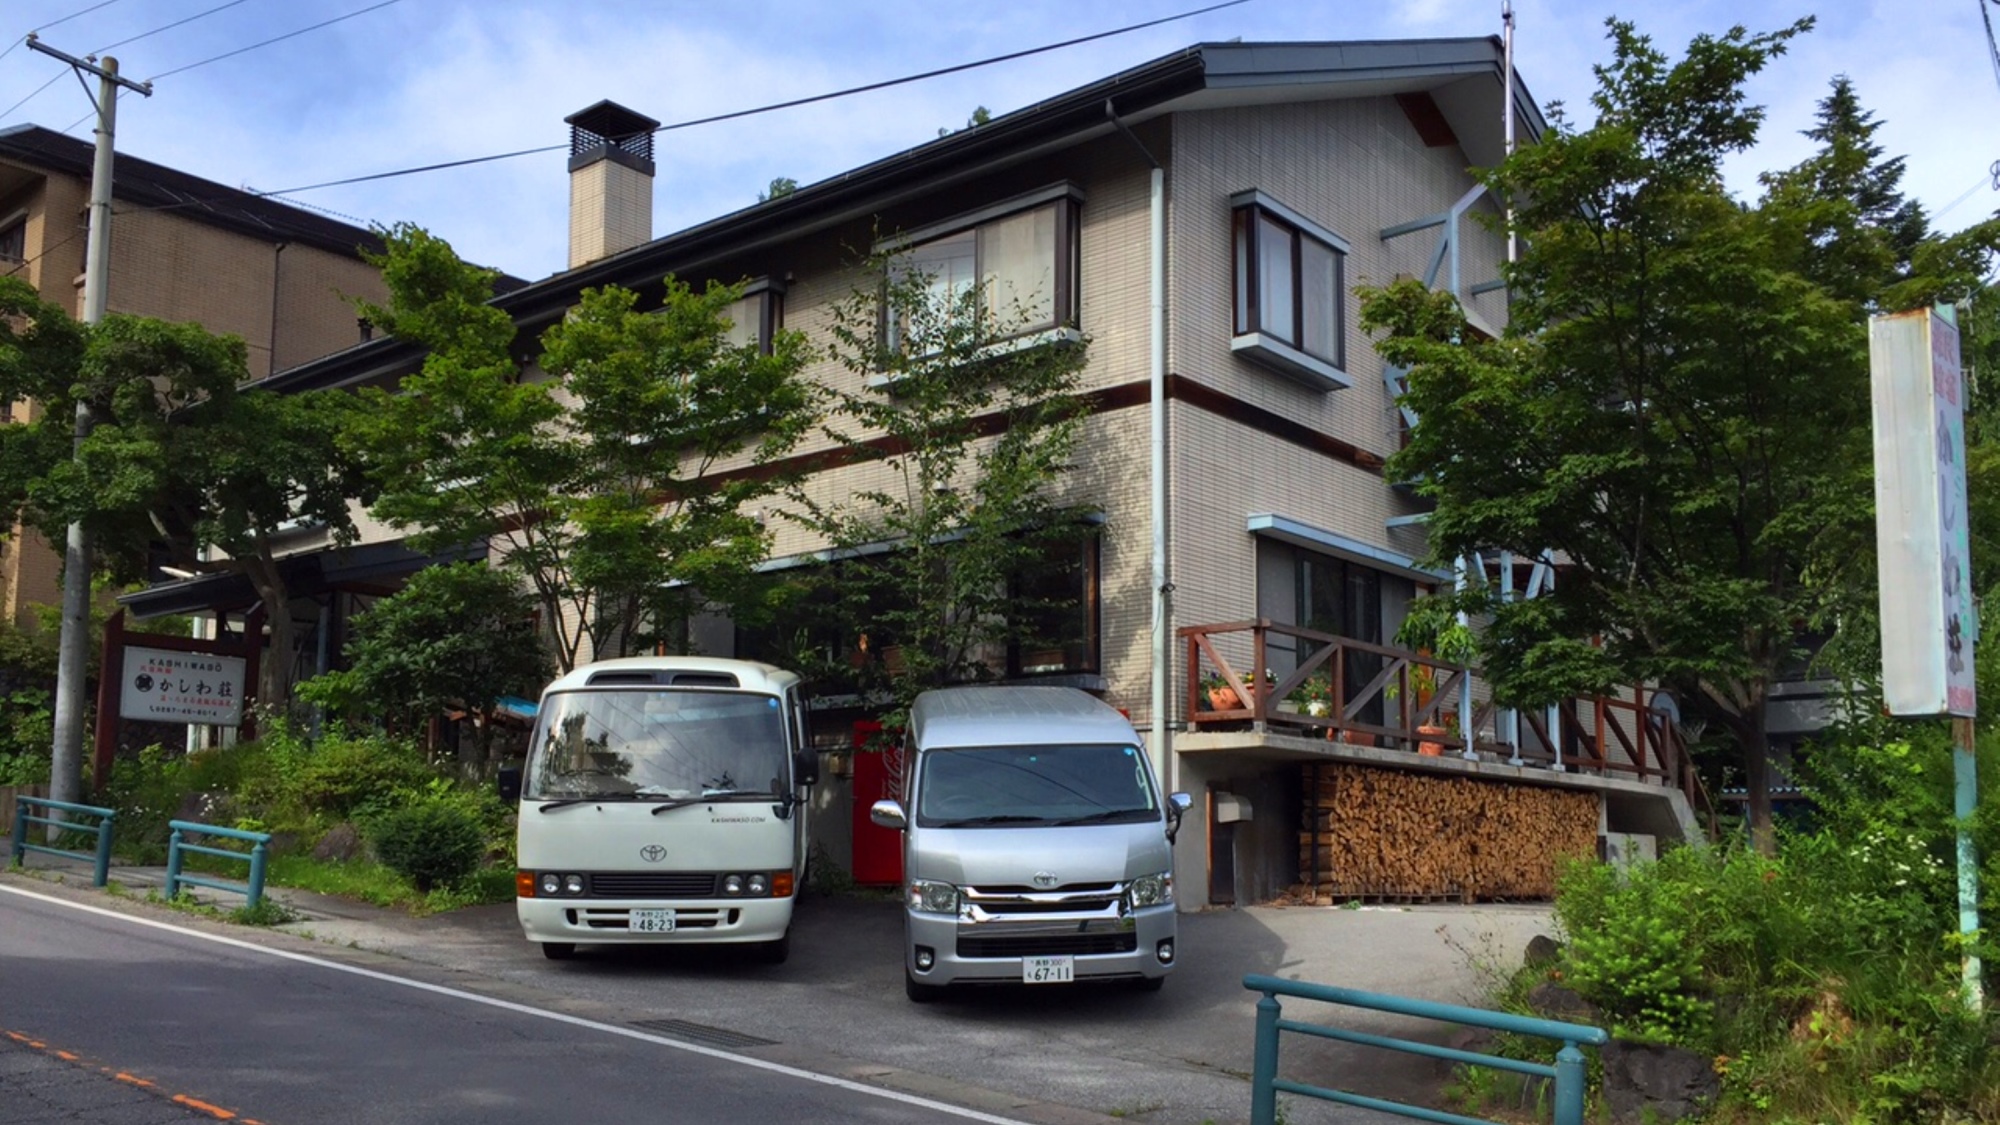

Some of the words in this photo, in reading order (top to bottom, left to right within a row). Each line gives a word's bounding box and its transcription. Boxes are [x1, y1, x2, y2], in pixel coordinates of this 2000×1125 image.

[160, 679, 233, 697] かしわ荘
[639, 919, 673, 931] 48-23
[1035, 967, 1069, 981] 67-11
